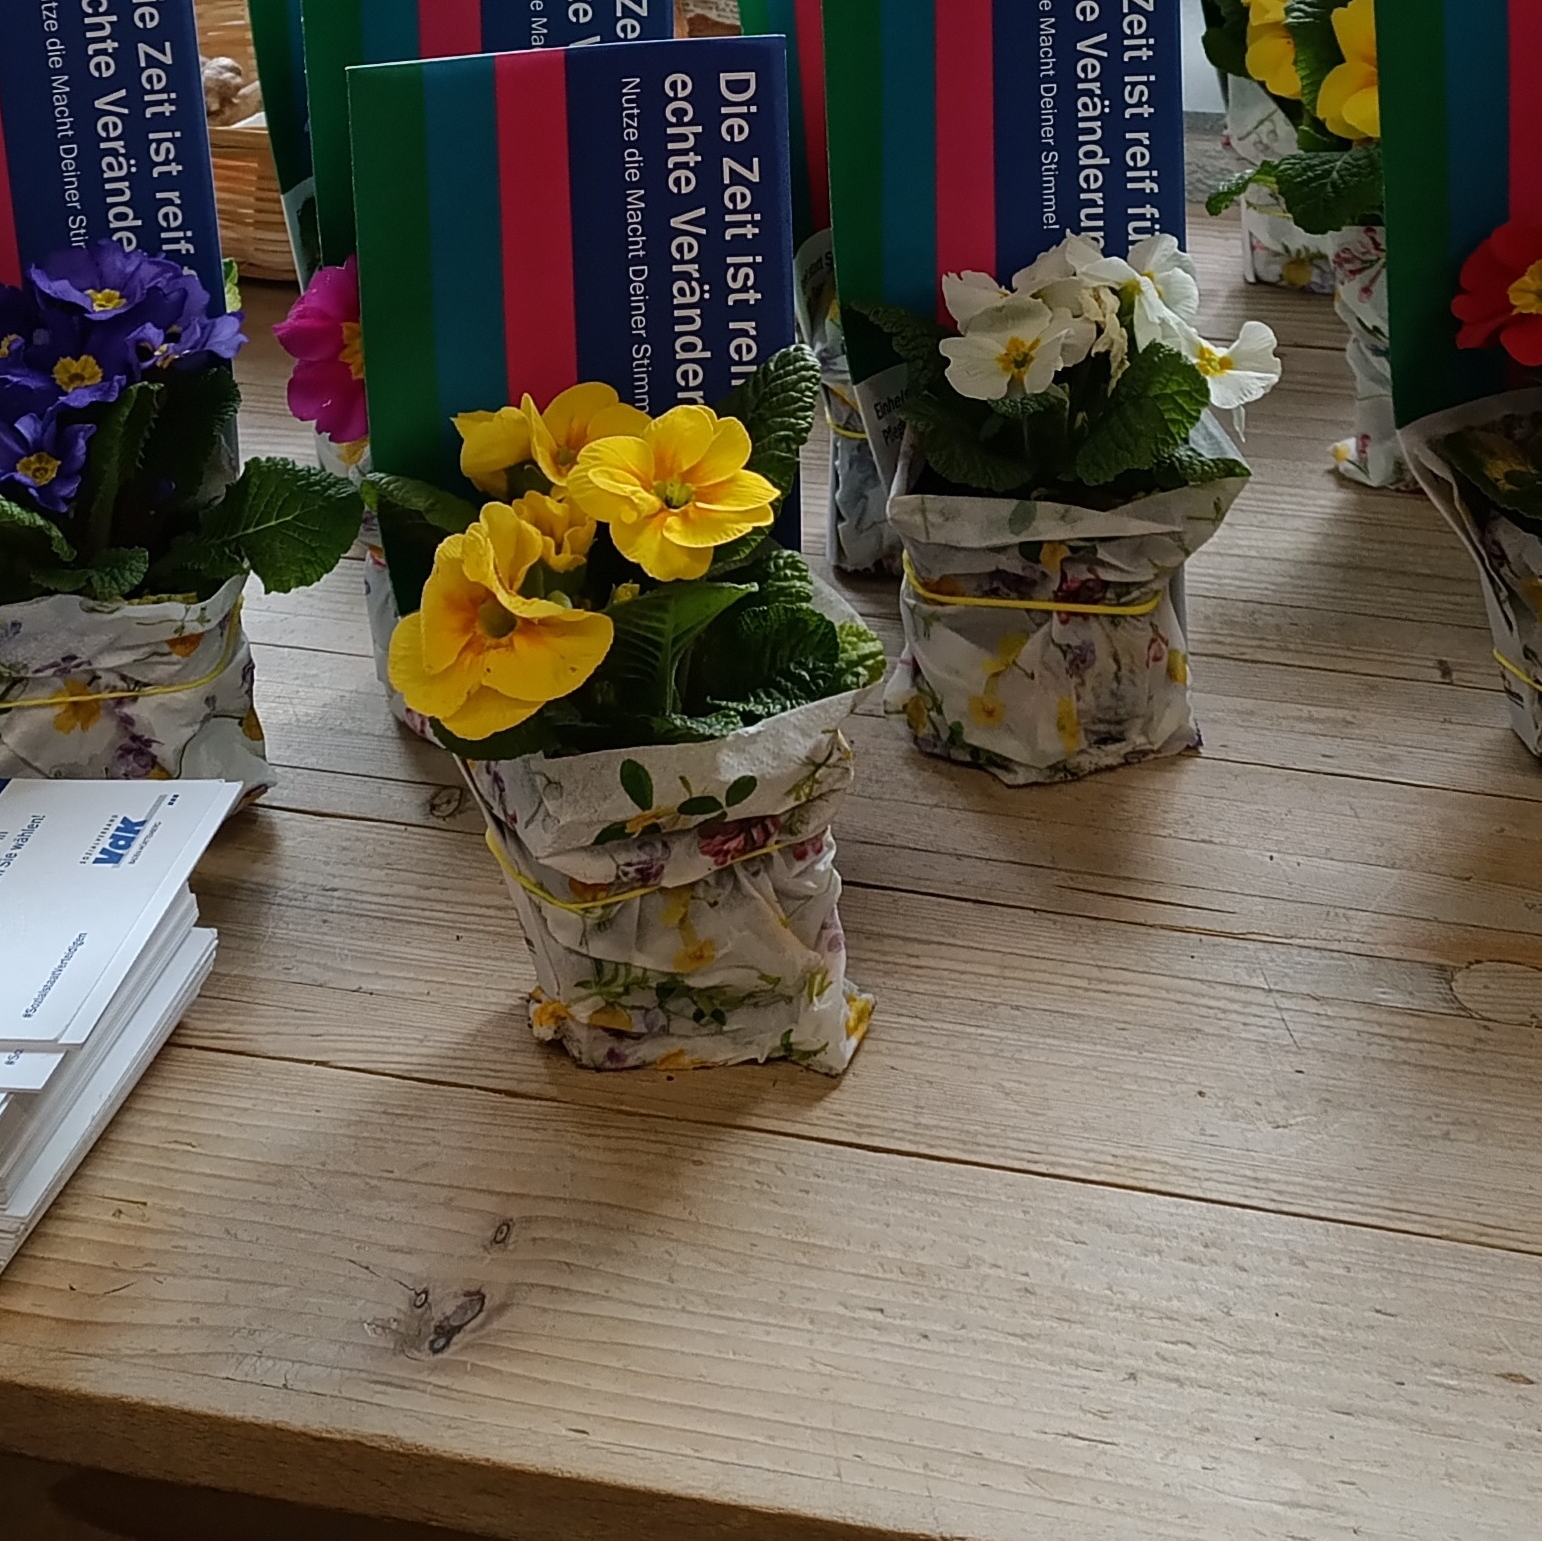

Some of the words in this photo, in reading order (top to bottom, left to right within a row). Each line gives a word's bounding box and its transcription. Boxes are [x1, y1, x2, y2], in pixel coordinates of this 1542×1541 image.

[46, 38, 65, 69] die
[1038, 17, 1058, 79] Macht
[50, 74, 74, 139] Macht
[137, 42, 177, 119] Zeit
[620, 77, 641, 142] Nutze
[719, 71, 758, 143] Die
[1123, 74, 1157, 119] ist
[664, 72, 704, 195] echte
[1039, 83, 1058, 147] Deiner
[60, 144, 80, 210] Deiner
[148, 131, 182, 178] ist
[623, 148, 645, 183] die
[1125, 131, 1159, 193] reif
[722, 157, 761, 241] Zeit
[1041, 150, 1060, 230] Stimme!
[155, 191, 195, 255] reif
[624, 188, 647, 259] Macht
[628, 265, 648, 337] Deiner
[726, 255, 763, 306] ist
[10, 814, 47, 854] wählen!
[92, 815, 148, 866] VdK
